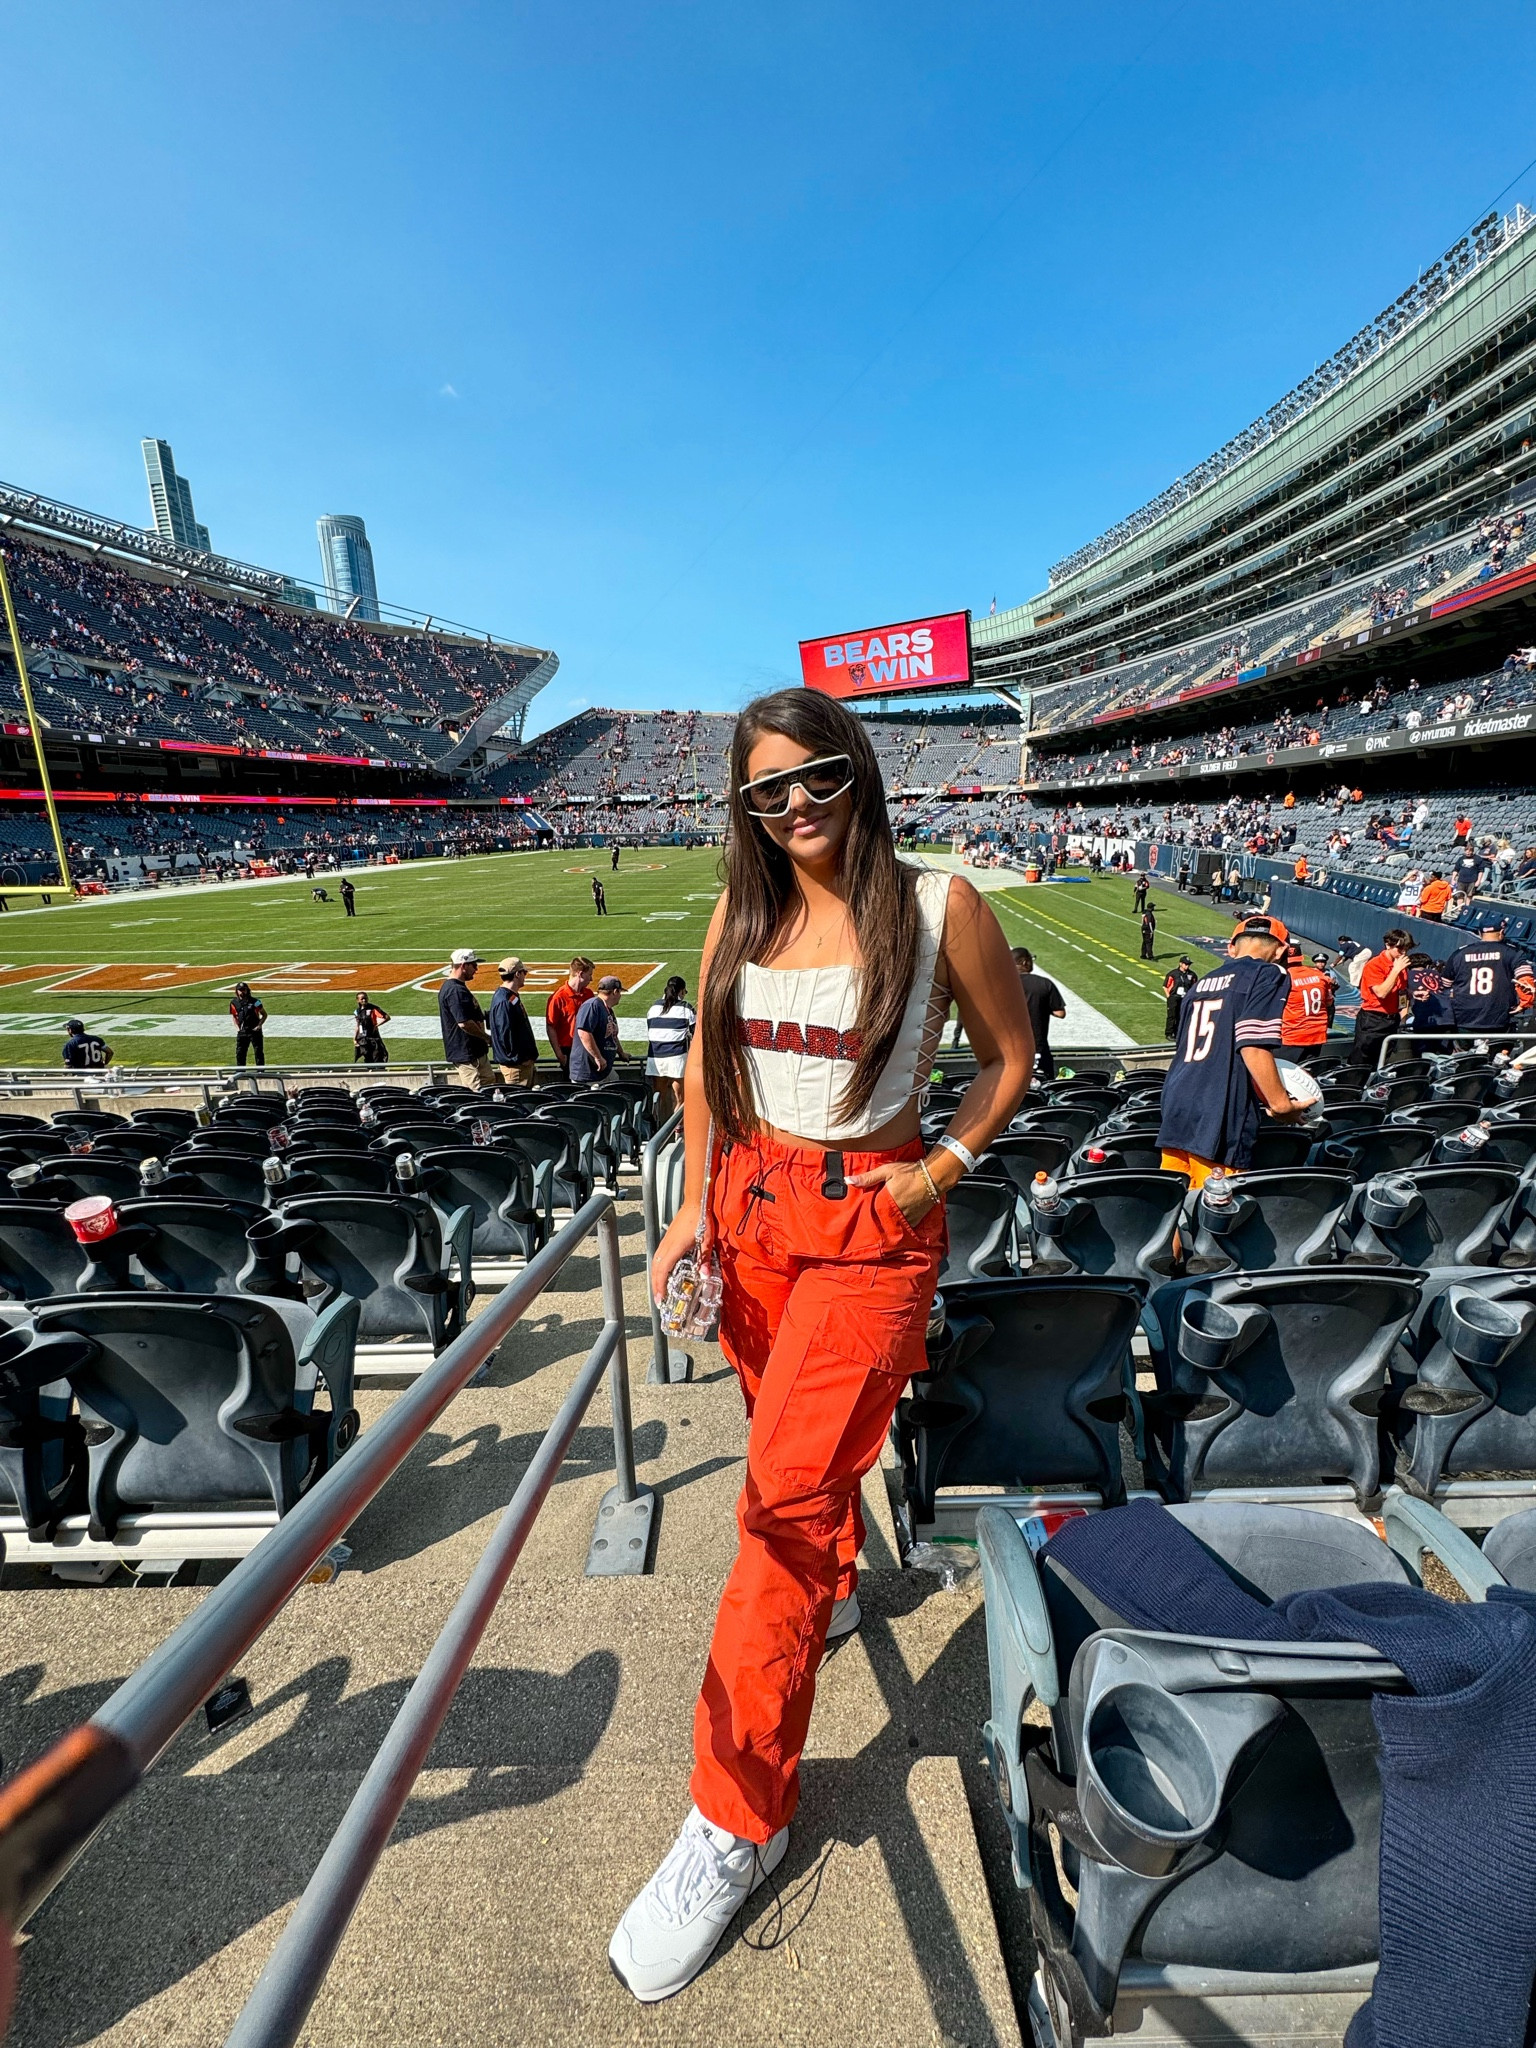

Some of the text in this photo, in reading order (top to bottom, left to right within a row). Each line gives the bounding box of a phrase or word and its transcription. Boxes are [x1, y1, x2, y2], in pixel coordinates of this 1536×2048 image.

[823, 628, 934, 668] BEARS
[867, 653, 934, 683] WIN
[1421, 725, 1456, 738] HYUNDAI
[1464, 713, 1532, 737] ticketmaster
[1374, 736, 1390, 749] PNC
[1200, 760, 1238, 774] SOLDIER FIELD
[1067, 834, 1137, 869] BEARS
[1405, 885, 1419, 897] 98
[1464, 952, 1501, 963] WILLIAMS
[1293, 975, 1320, 987] WILLIAMS
[1469, 966, 1494, 995] 18
[1302, 987, 1322, 1017] 18
[1183, 998, 1224, 1063] 15
[78, 1041, 102, 1066] 76
